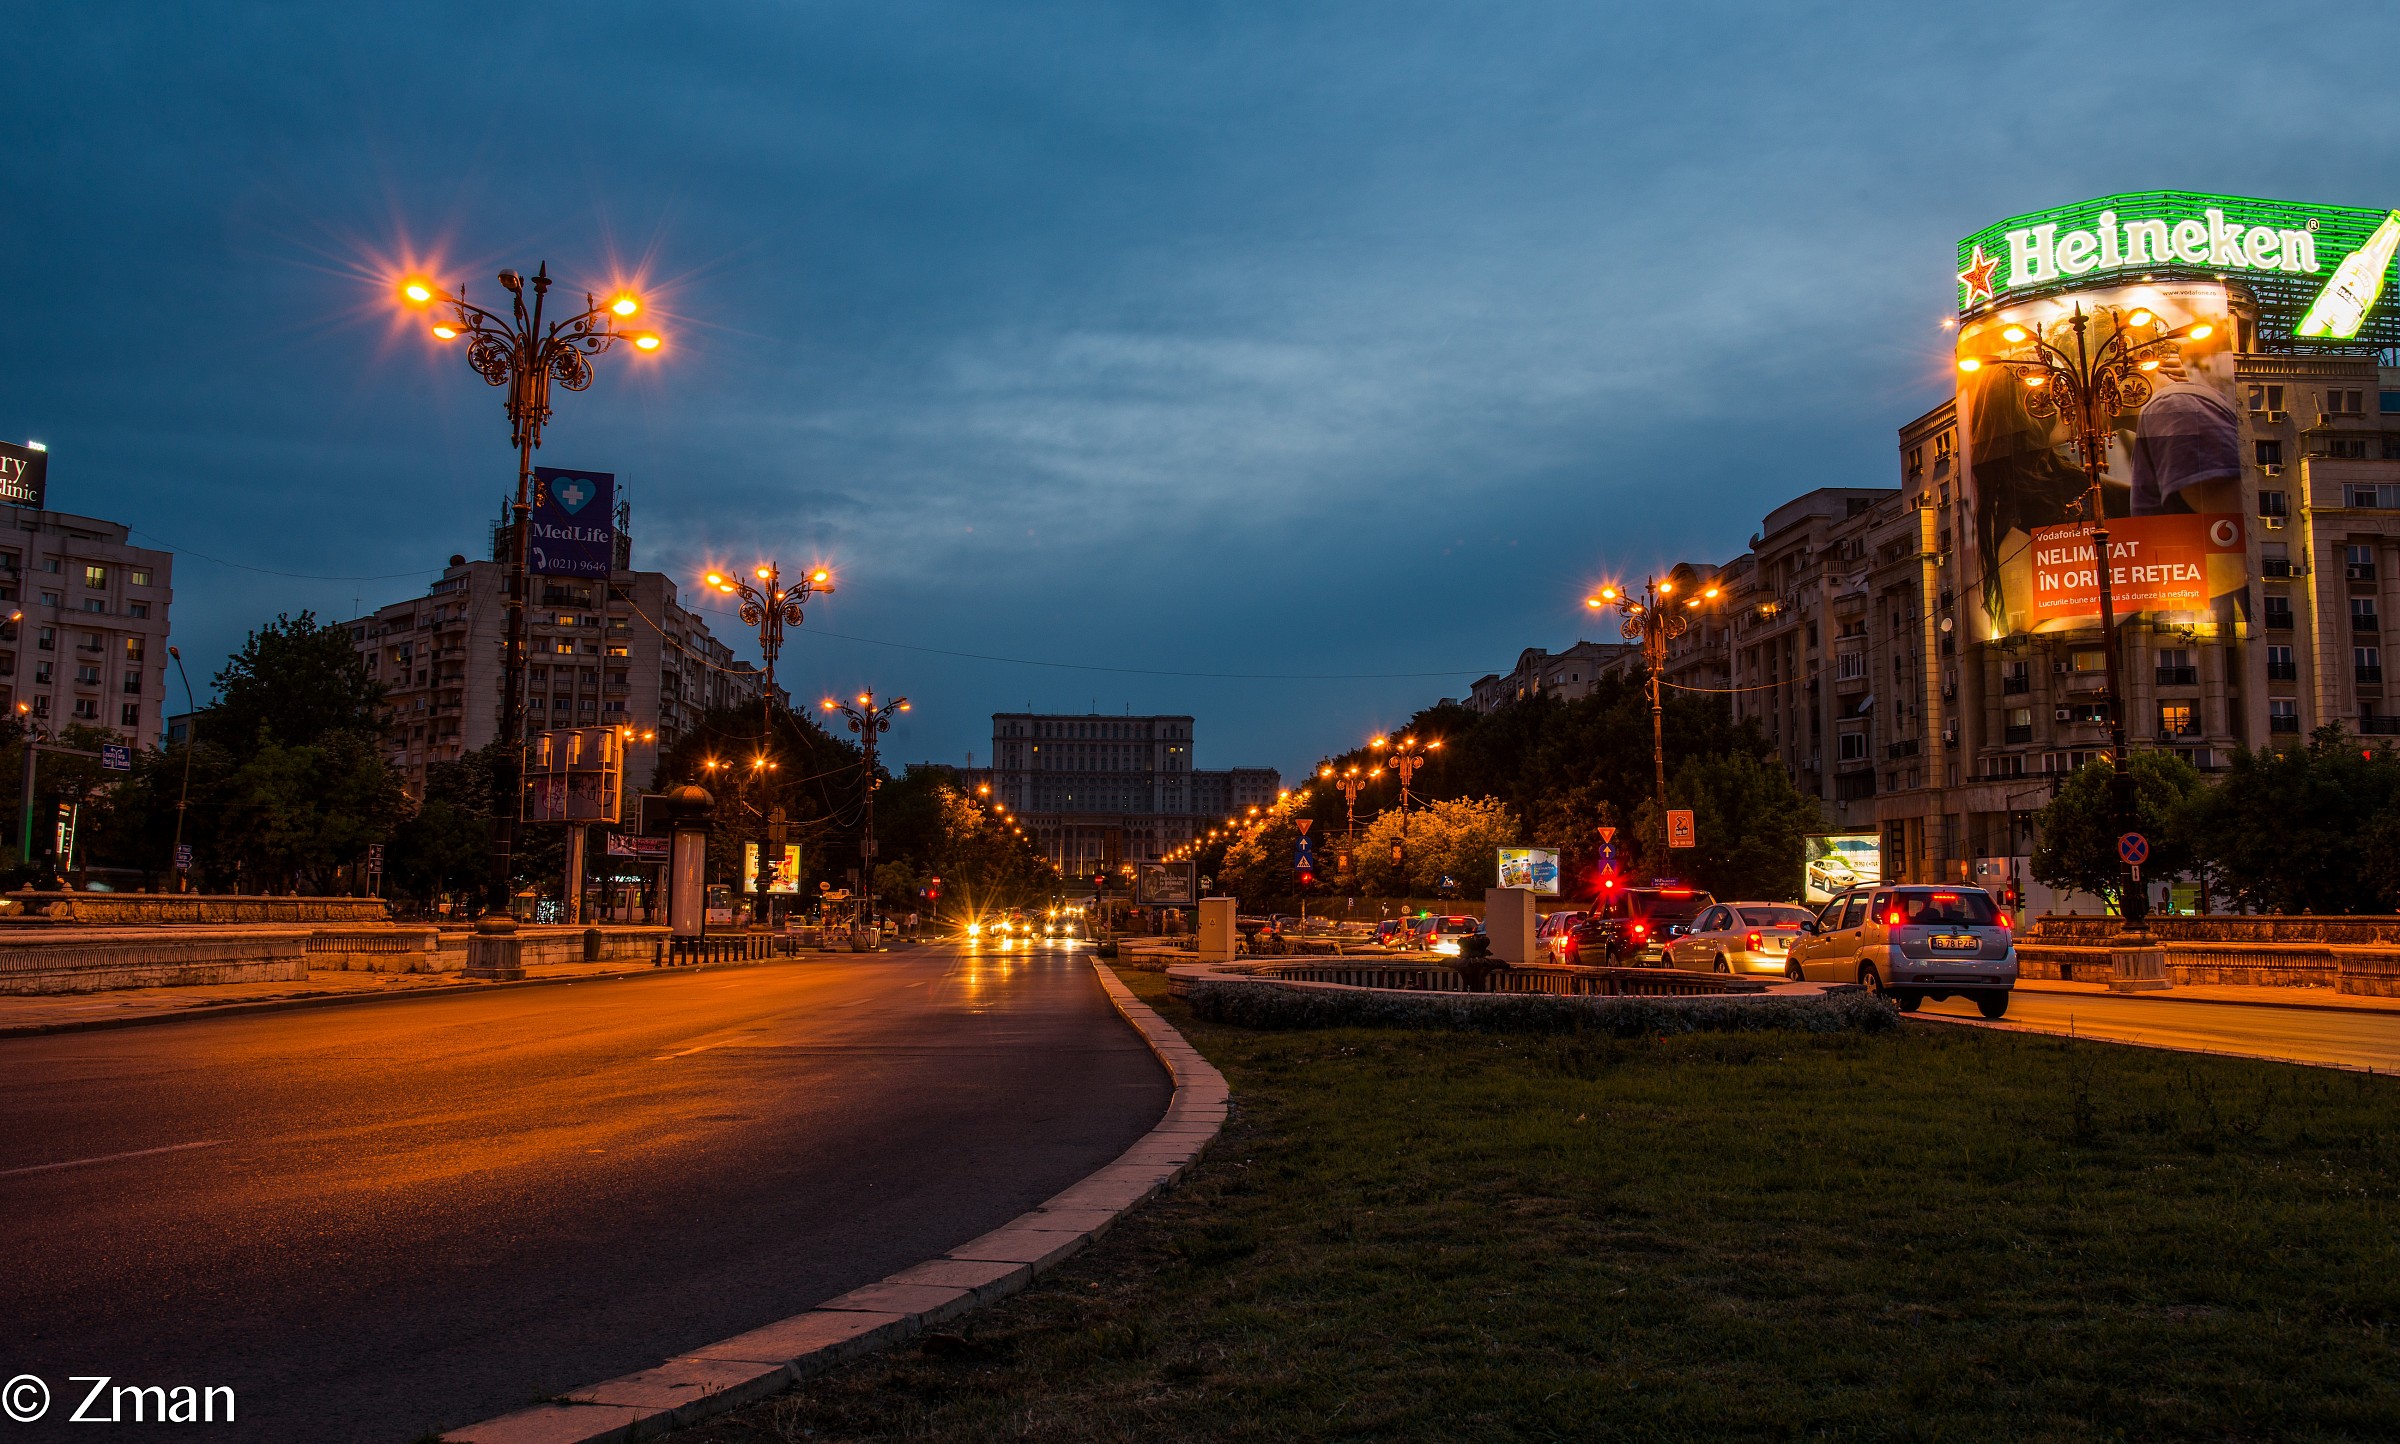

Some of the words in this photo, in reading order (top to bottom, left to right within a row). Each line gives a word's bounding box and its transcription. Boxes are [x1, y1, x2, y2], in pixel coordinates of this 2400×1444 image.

[2005, 208, 2321, 287] Heineken
[0, 478, 37, 502] linic
[532, 522, 609, 543] MedLife
[2036, 530, 2081, 541] Vodafone
[548, 558, 577, 571] (021)
[580, 560, 606, 571] 9646
[2037, 541, 2139, 567] NELIMTAT
[2038, 570, 2059, 591] ÎN
[2063, 567, 2127, 589] ORIE
[2131, 563, 2202, 586] REȚEA
[2038, 599, 2069, 608] Lucrurile
[2069, 597, 2089, 605] bune
[2121, 591, 2130, 601] să
[2131, 591, 2158, 600] dureze
[2158, 591, 2166, 599] la
[1937, 940, 1944, 948] B
[1945, 940, 1956, 948] 78
